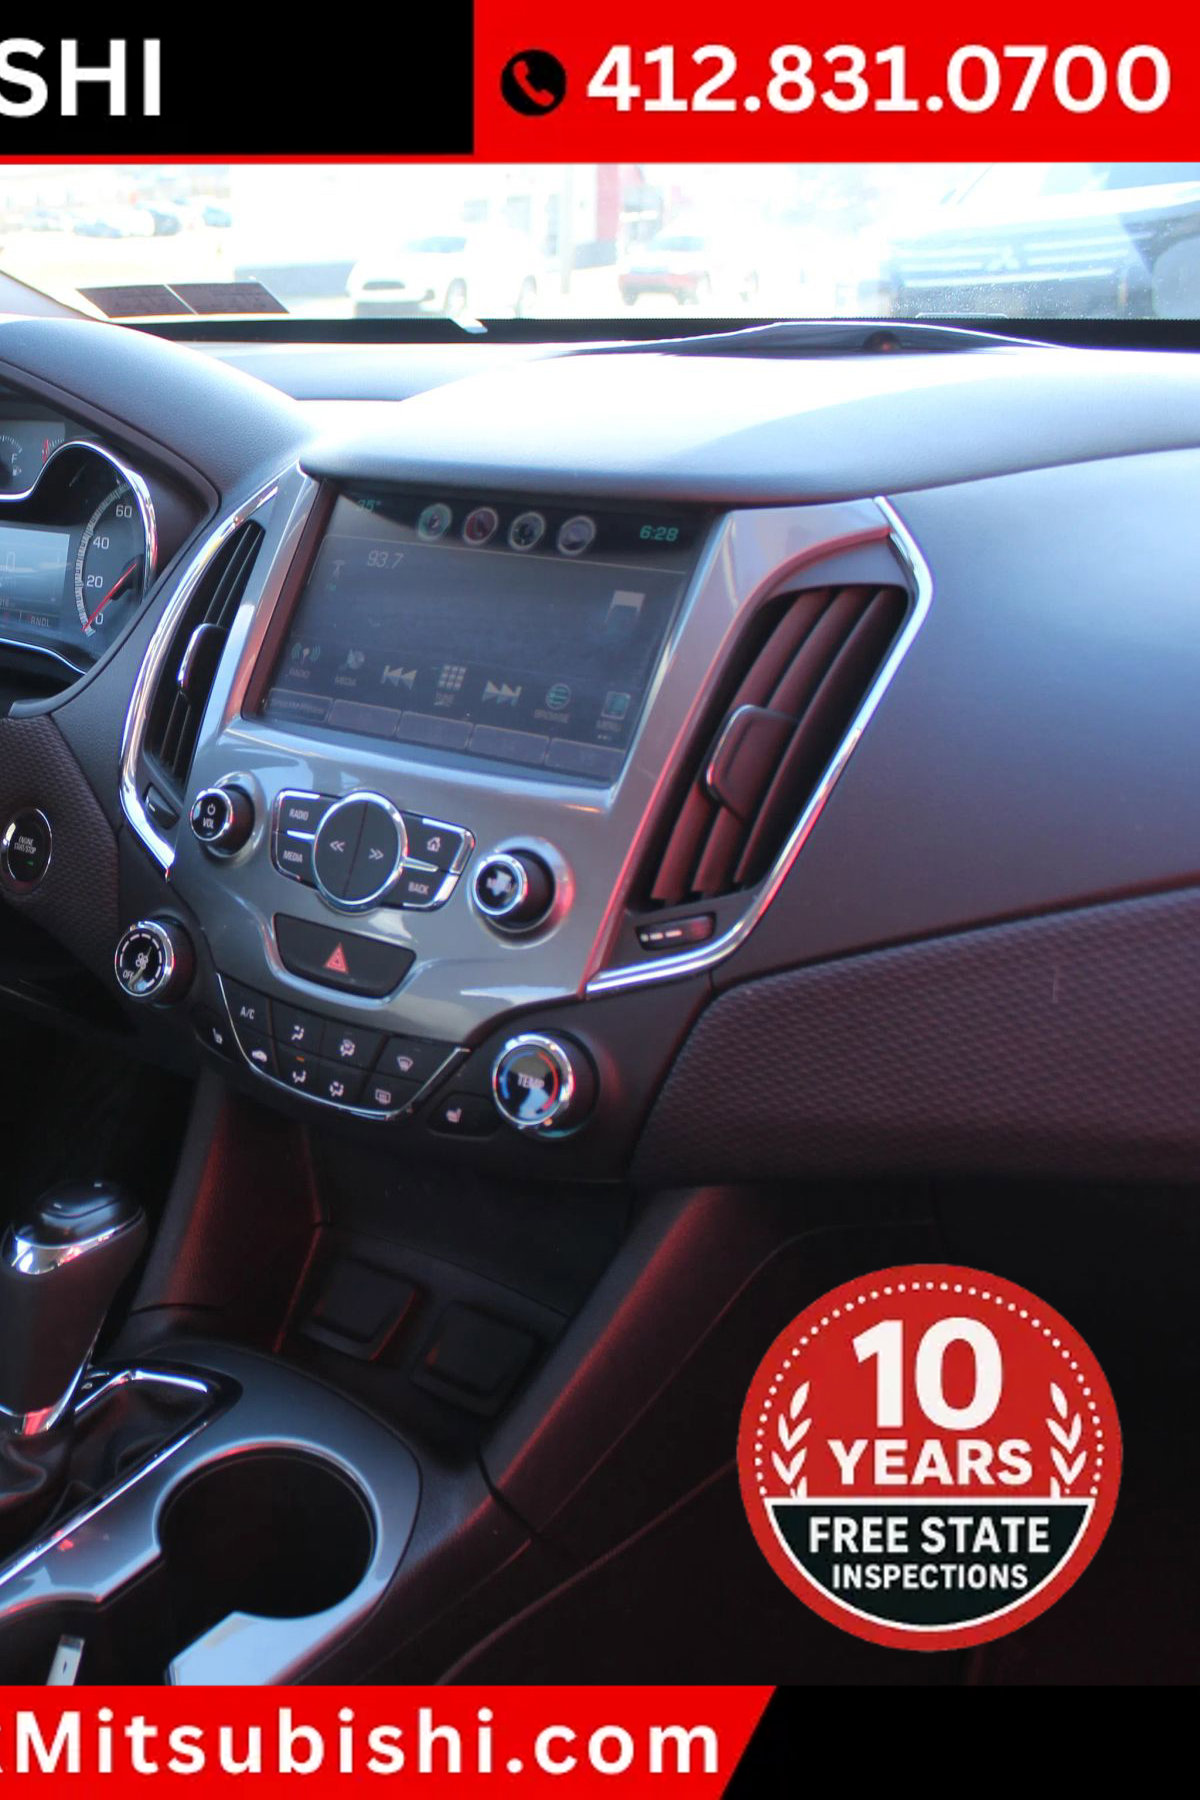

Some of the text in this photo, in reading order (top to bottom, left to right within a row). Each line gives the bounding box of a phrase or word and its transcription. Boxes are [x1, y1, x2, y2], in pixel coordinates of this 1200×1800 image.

[115, 504, 133, 518] 60
[640, 525, 679, 542] 6:28
[93, 536, 110, 550] 40
[367, 550, 404, 569] 93.7
[86, 575, 103, 588] 20
[95, 612, 104, 625] 0
[288, 807, 310, 821] RADIO
[202, 817, 215, 830] VOL
[282, 849, 304, 863] MEDIA
[407, 881, 430, 895] BACK
[240, 1005, 256, 1020] A/C
[517, 1072, 545, 1090] TEMP
